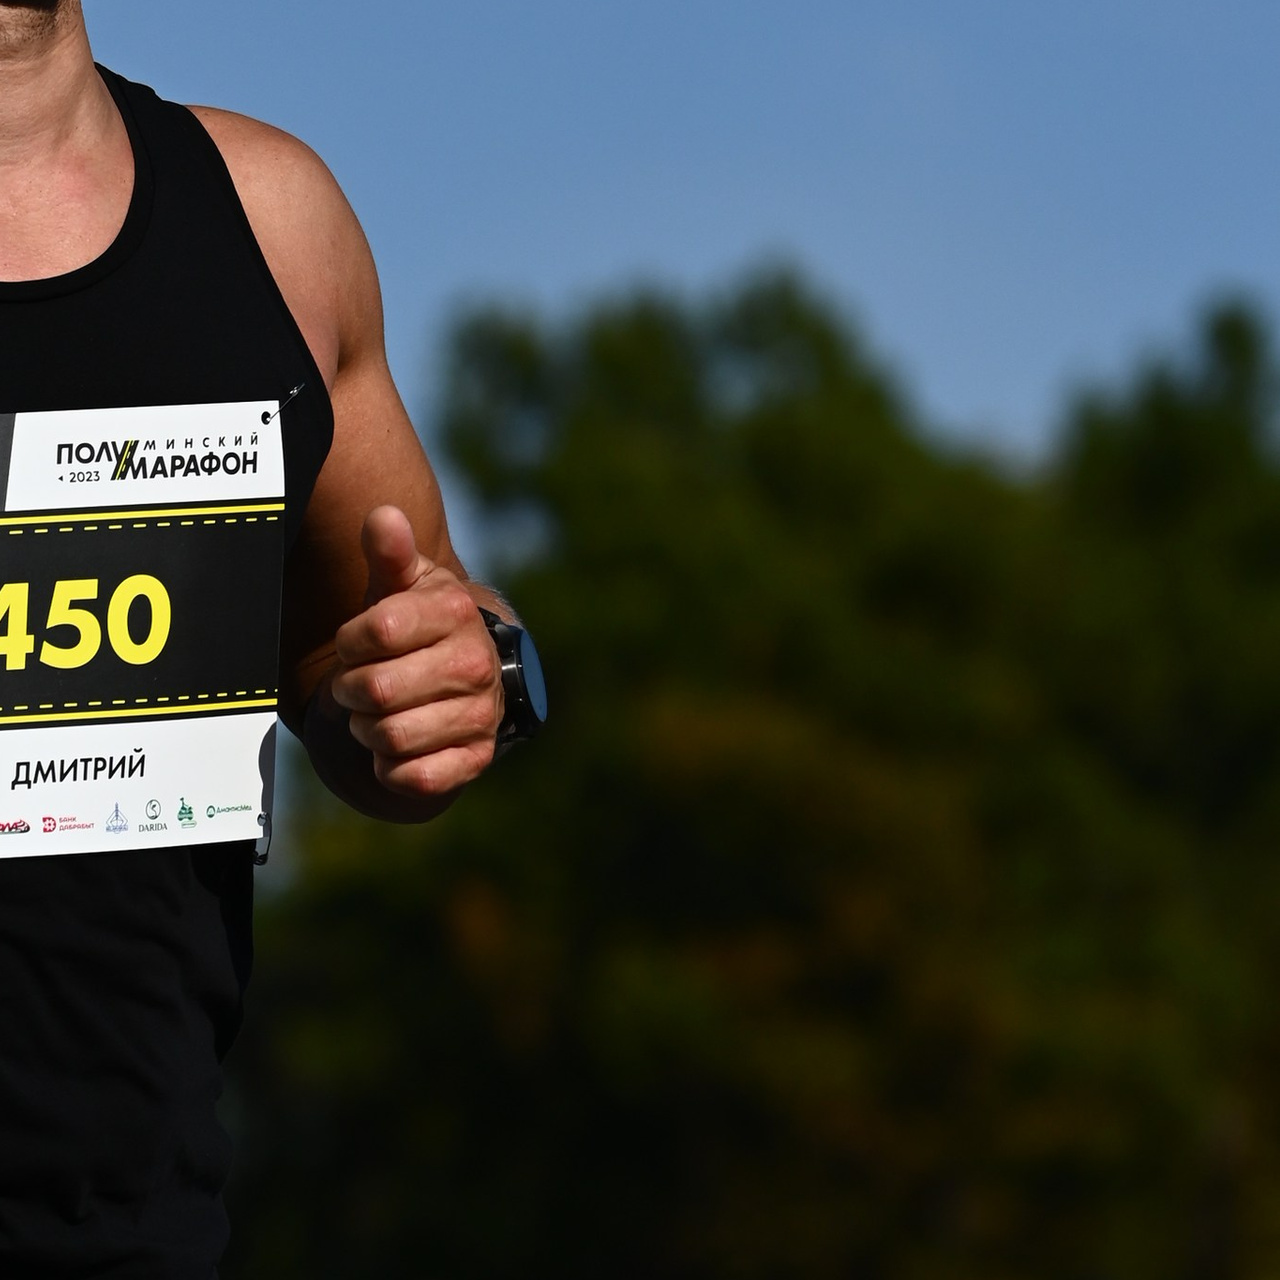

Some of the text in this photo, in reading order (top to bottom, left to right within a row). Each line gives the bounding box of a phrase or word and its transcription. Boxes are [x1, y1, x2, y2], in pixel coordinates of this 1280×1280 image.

[143, 432, 259, 451] МИНСКИЙ
[57, 440, 139, 477] ПОЛУ
[111, 451, 258, 480] МАРАФОН
[69, 471, 101, 483] 2023
[11, 748, 146, 790] ДМИТРИЙ
[138, 823, 168, 832] DARIDA
